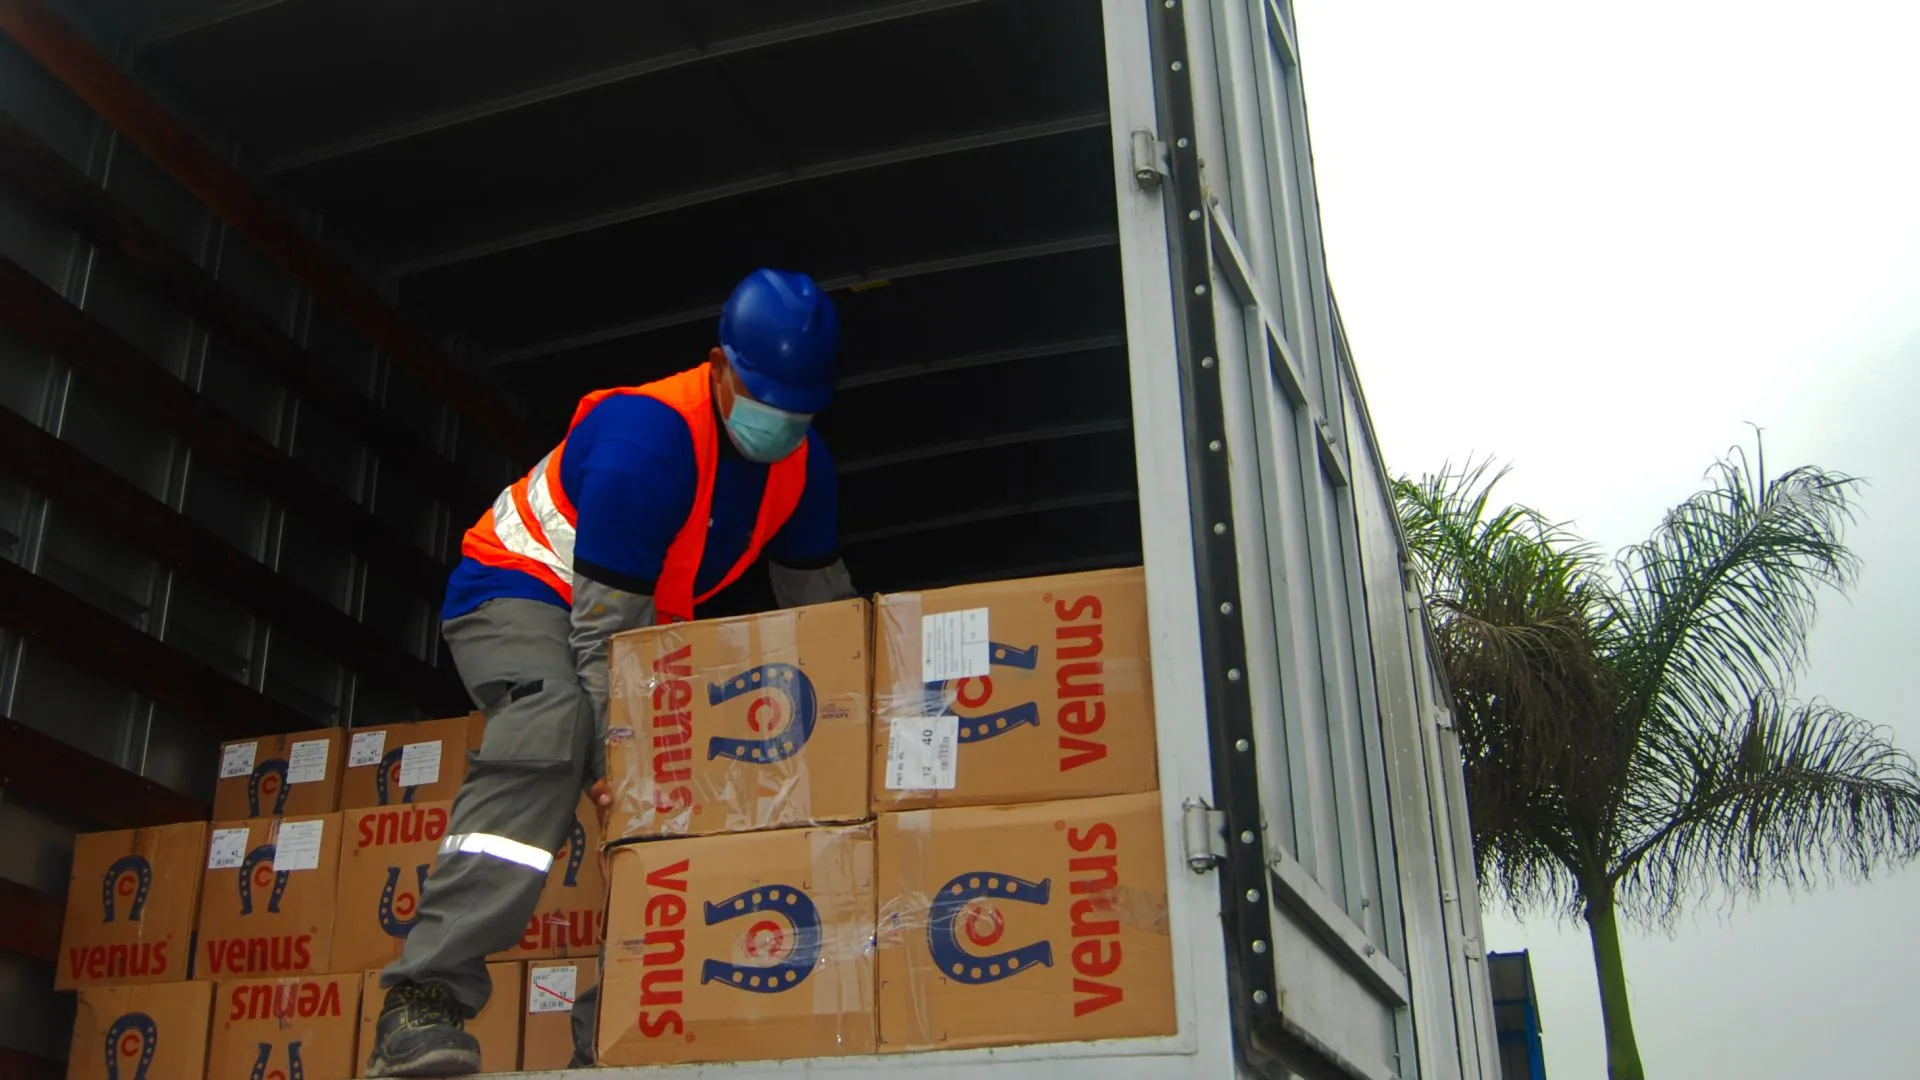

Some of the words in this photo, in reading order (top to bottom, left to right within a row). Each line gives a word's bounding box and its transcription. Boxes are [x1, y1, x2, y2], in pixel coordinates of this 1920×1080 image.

[1055, 595, 1108, 772] venus
[652, 644, 693, 814] venus
[921, 729, 933, 746] 40
[357, 807, 448, 848] enus
[514, 910, 603, 951] enu
[1067, 823, 1123, 1017] venus
[68, 940, 169, 981] venus
[205, 934, 312, 975] venus
[638, 859, 690, 1039] venus
[229, 981, 342, 1022] venus
